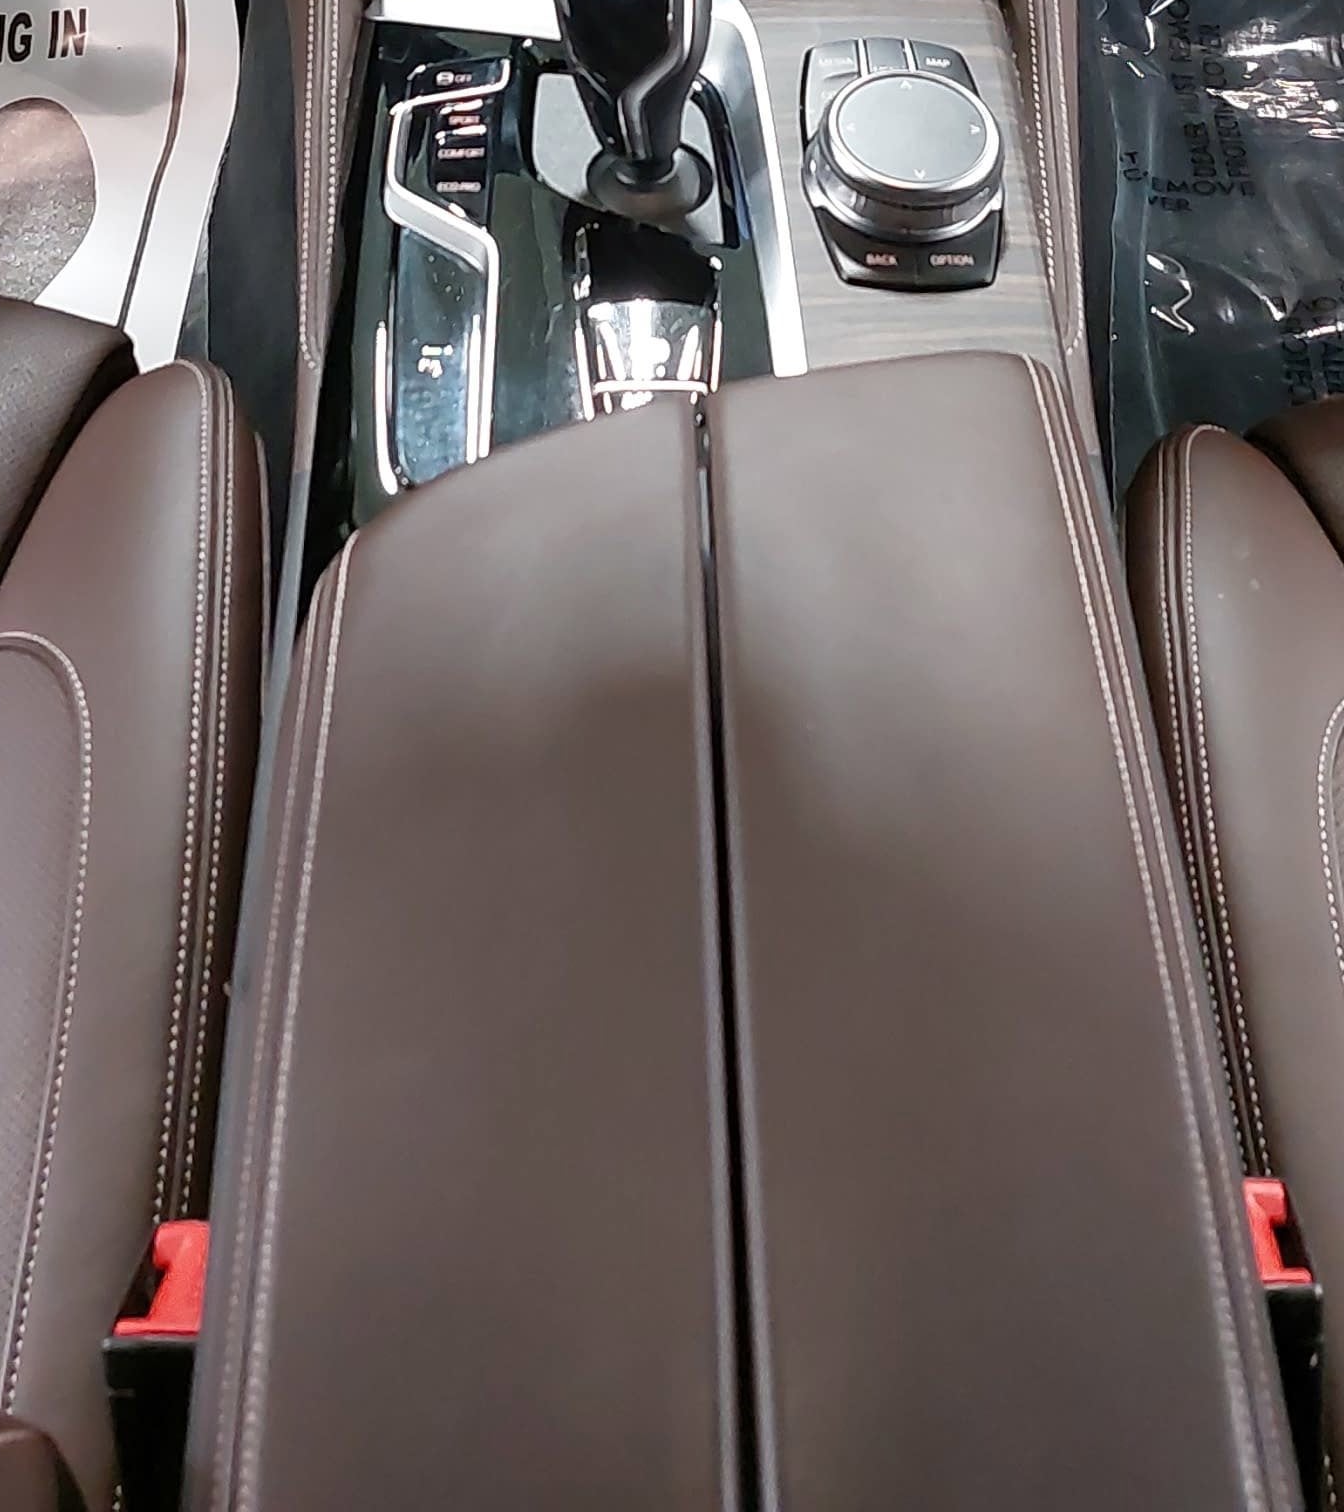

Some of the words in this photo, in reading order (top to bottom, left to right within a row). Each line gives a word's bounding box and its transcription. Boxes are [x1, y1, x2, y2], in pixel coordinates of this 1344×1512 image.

[47, 7, 87, 59] IN
[925, 56, 952, 68] MAP
[929, 253, 976, 267] OPTION
